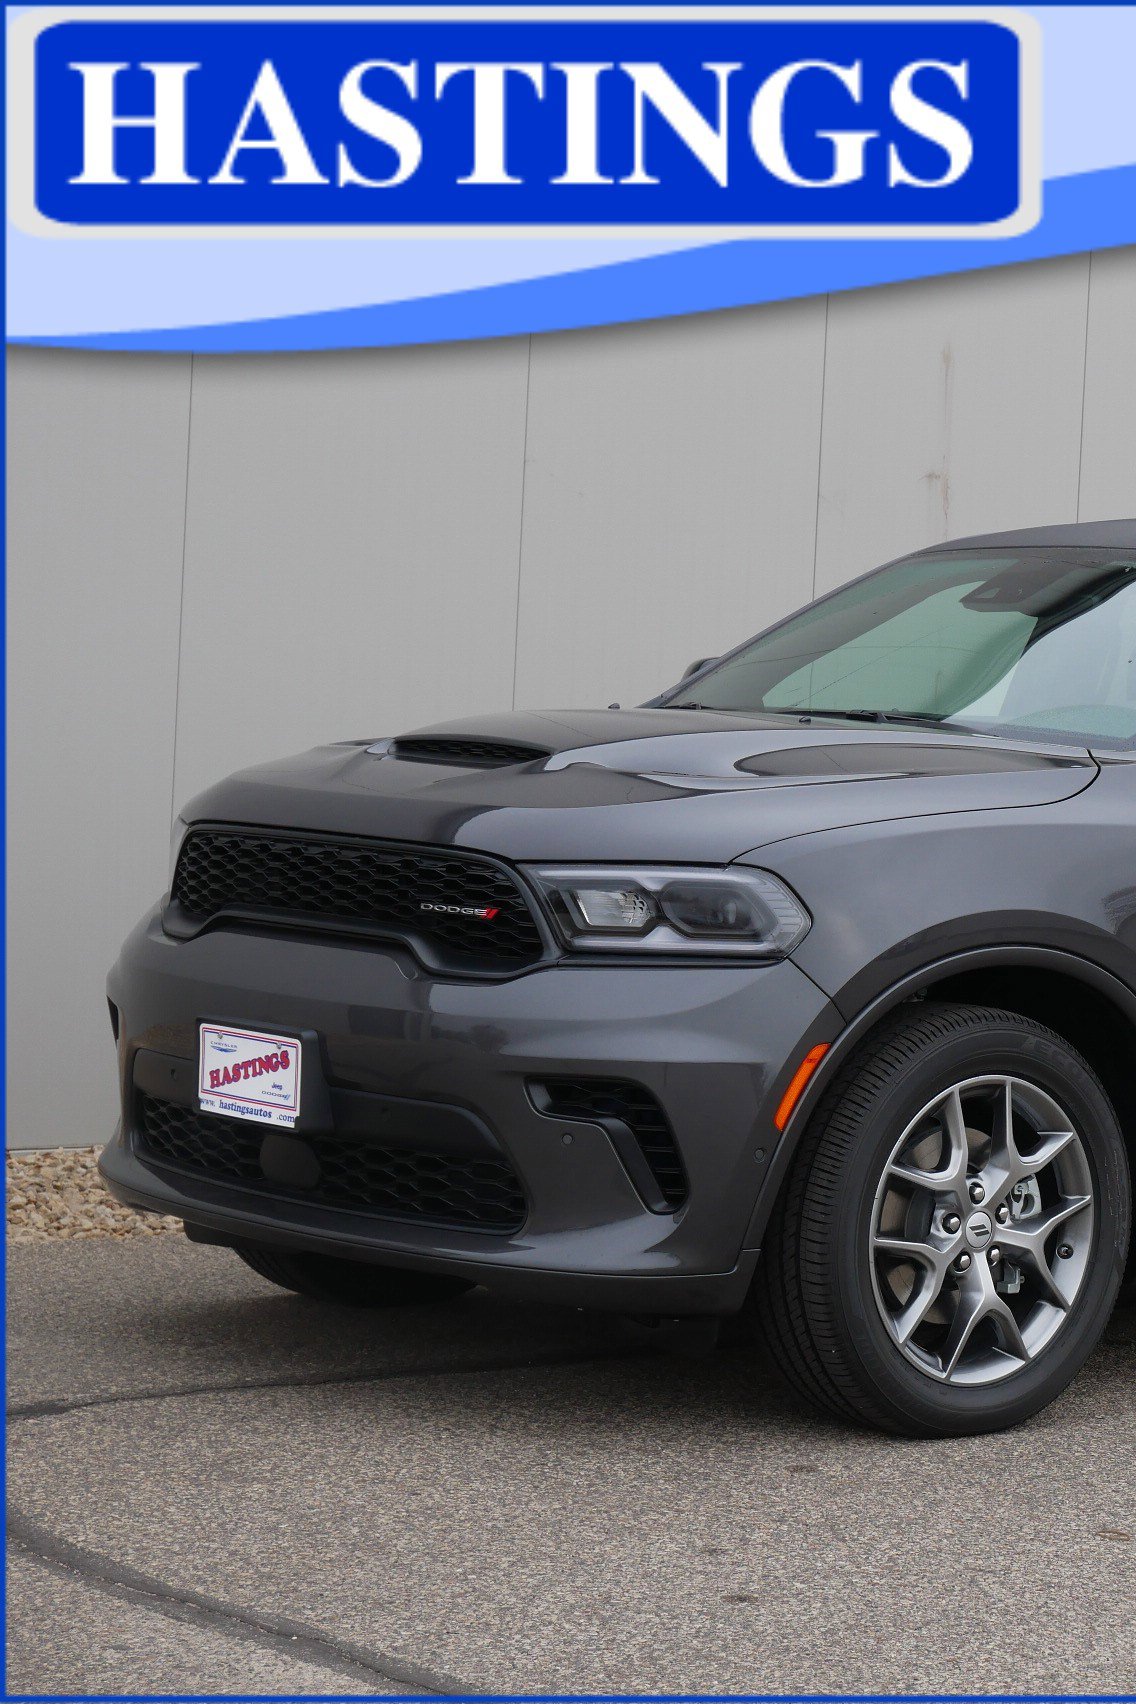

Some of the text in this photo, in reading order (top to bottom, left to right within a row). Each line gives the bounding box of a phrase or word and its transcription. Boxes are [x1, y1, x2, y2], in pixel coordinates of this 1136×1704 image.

[420, 903, 488, 916] DODGE
[209, 1050, 290, 1089] HASTINGS
[218, 1099, 272, 1118] hastingsautos
